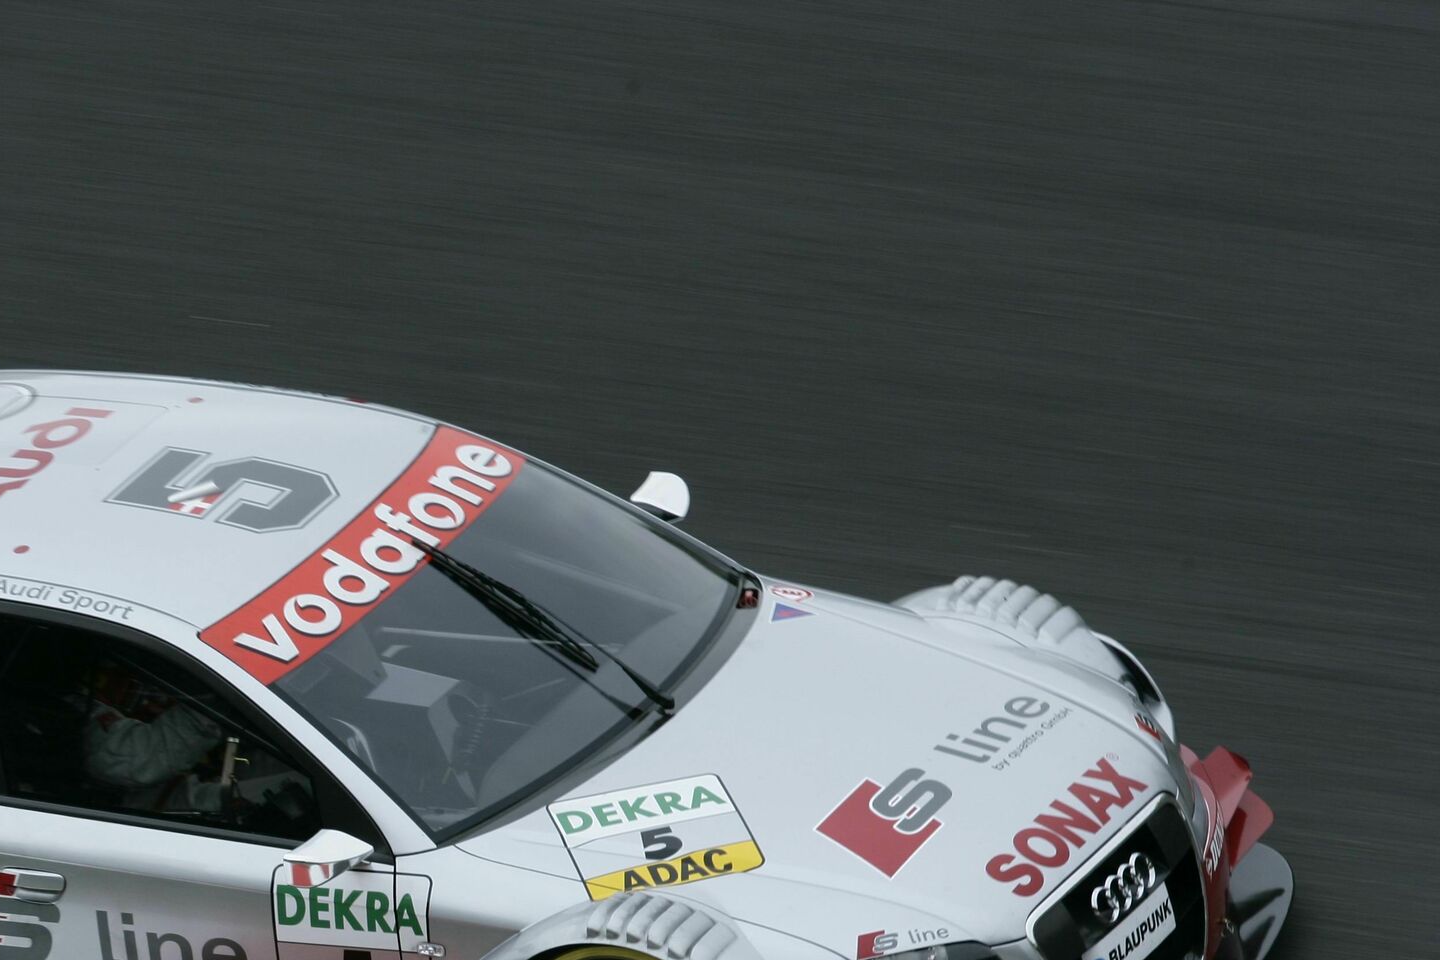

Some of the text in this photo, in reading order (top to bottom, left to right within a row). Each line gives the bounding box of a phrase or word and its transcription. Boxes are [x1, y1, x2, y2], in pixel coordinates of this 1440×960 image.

[103, 445, 341, 534] 5
[233, 444, 512, 663] vodafone
[58, 589, 134, 620] Sport
[870, 696, 1050, 834] S line
[555, 785, 727, 835] DEKRA
[985, 756, 1149, 897] SONAX
[640, 826, 683, 860] 5
[623, 848, 733, 893] ADAC
[276, 884, 424, 936] DEKRA
[907, 927, 950, 944] line
